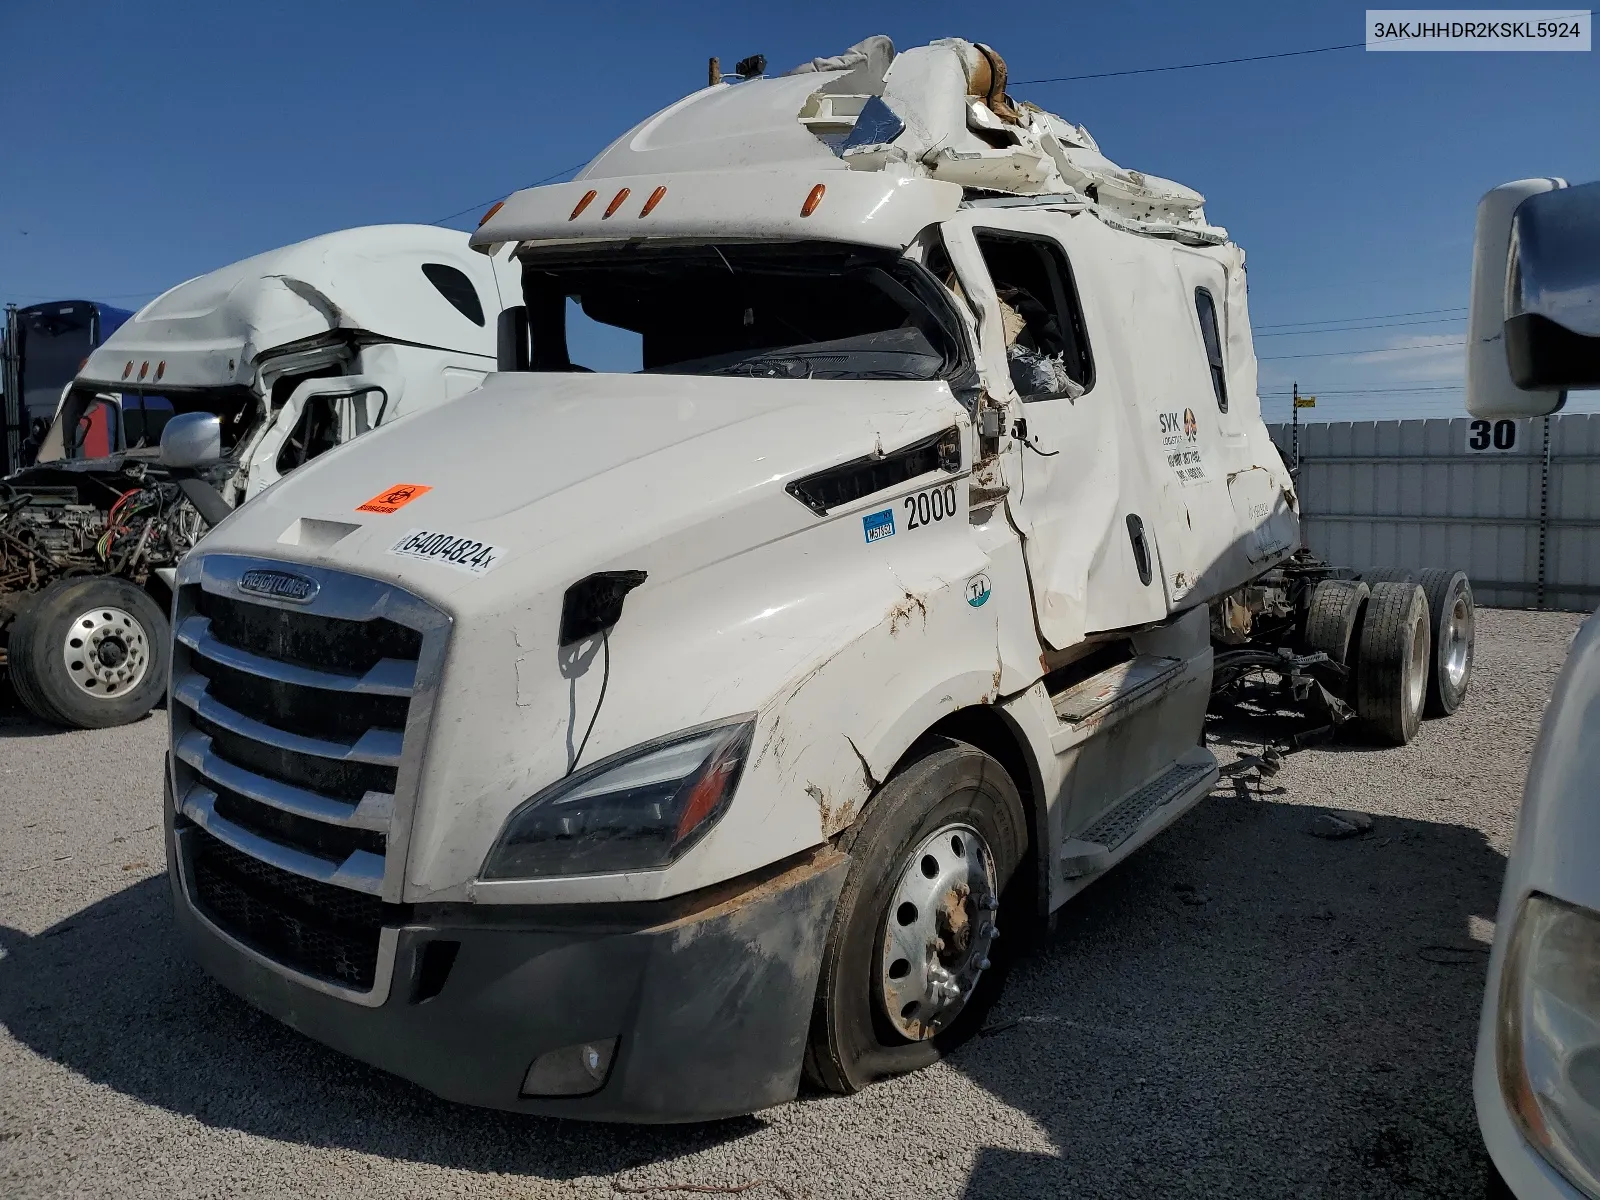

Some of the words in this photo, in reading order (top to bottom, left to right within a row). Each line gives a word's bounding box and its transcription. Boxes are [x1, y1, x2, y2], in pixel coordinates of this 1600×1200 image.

[1159, 412, 1181, 434] SVK
[1469, 419, 1516, 451] 30
[904, 484, 957, 531] 2000
[242, 572, 309, 597] FREIGHTLINER
[970, 579, 985, 600] TJ
